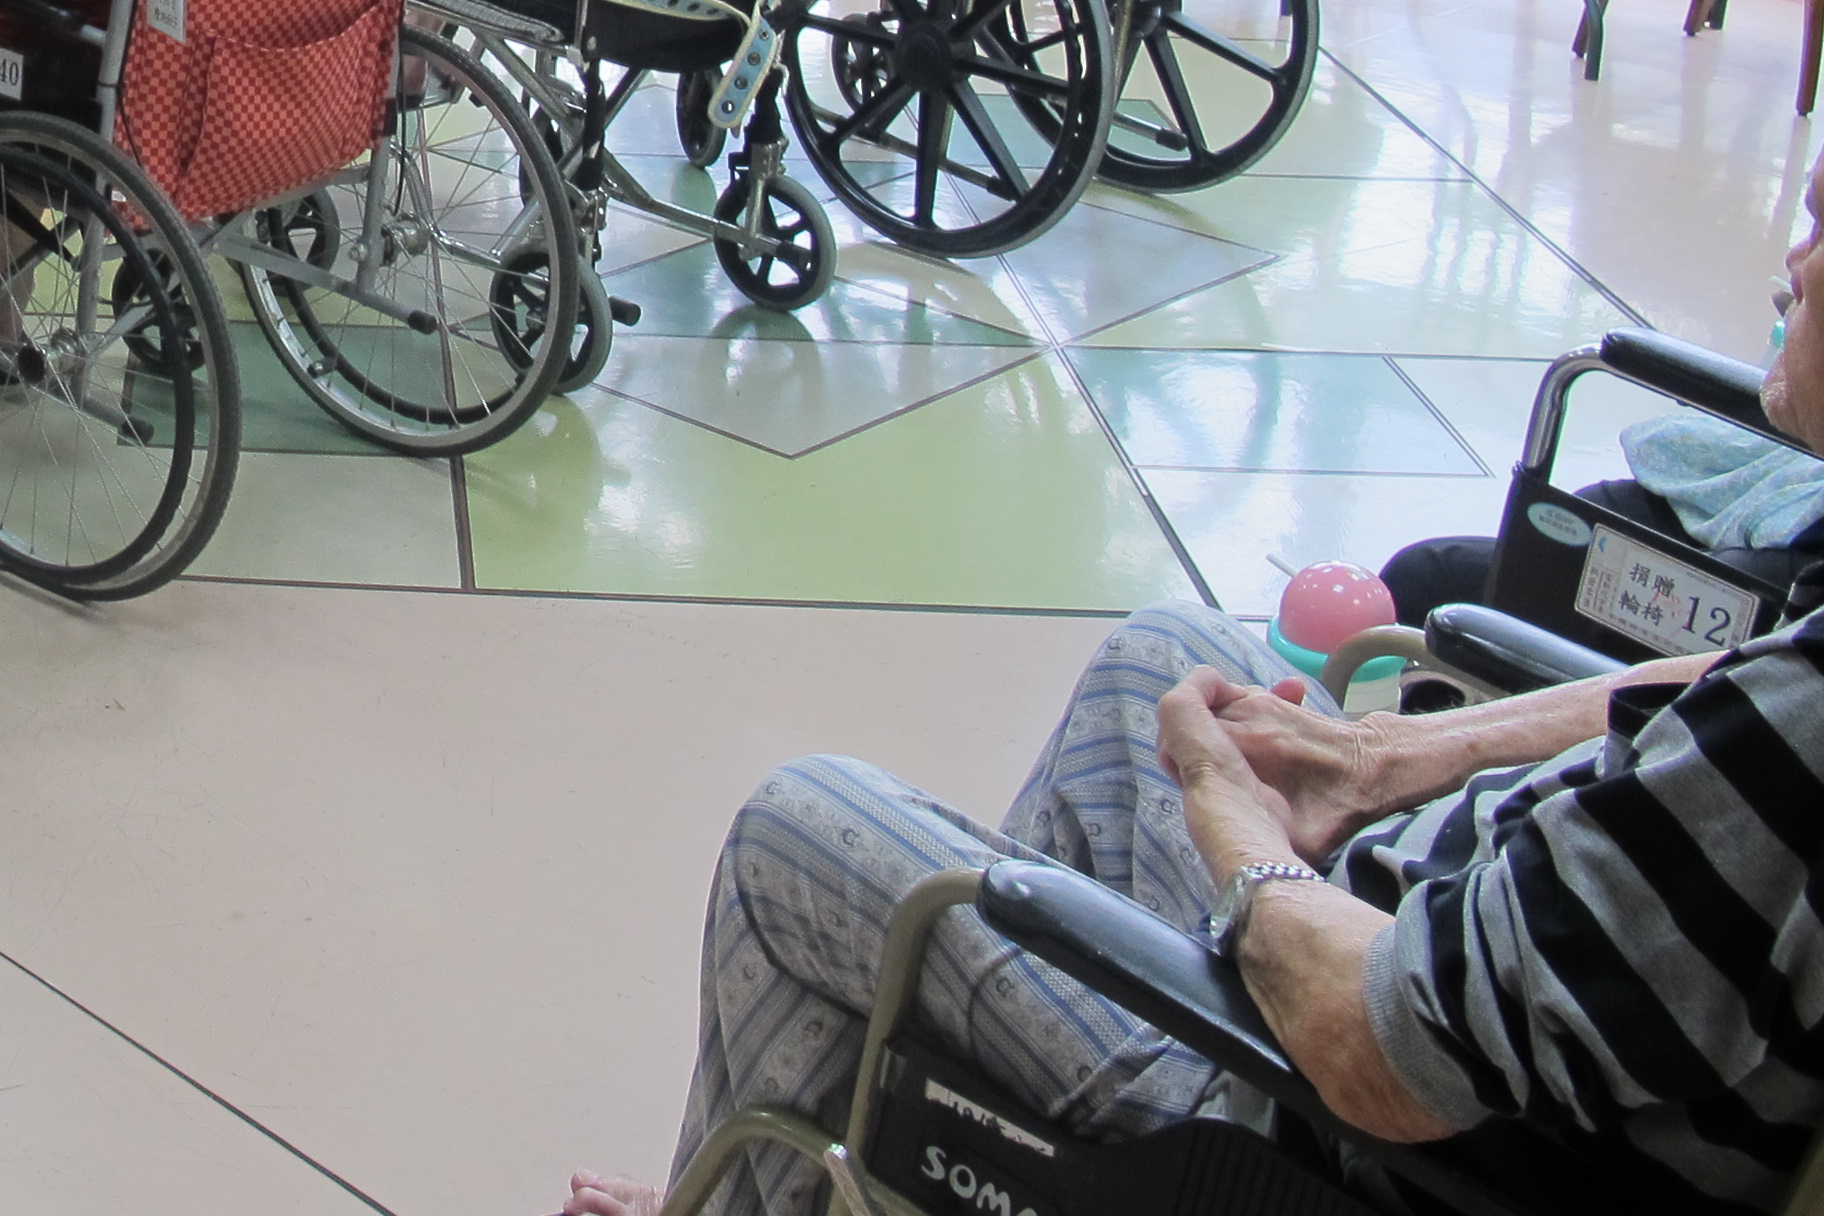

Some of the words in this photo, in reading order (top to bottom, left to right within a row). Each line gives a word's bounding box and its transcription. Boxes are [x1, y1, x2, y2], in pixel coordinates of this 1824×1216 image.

[1629, 563, 1675, 598] 捐贈
[1619, 590, 1664, 626] 輪椅
[1681, 595, 1731, 647] 12
[920, 1145, 1038, 1216] SOM
